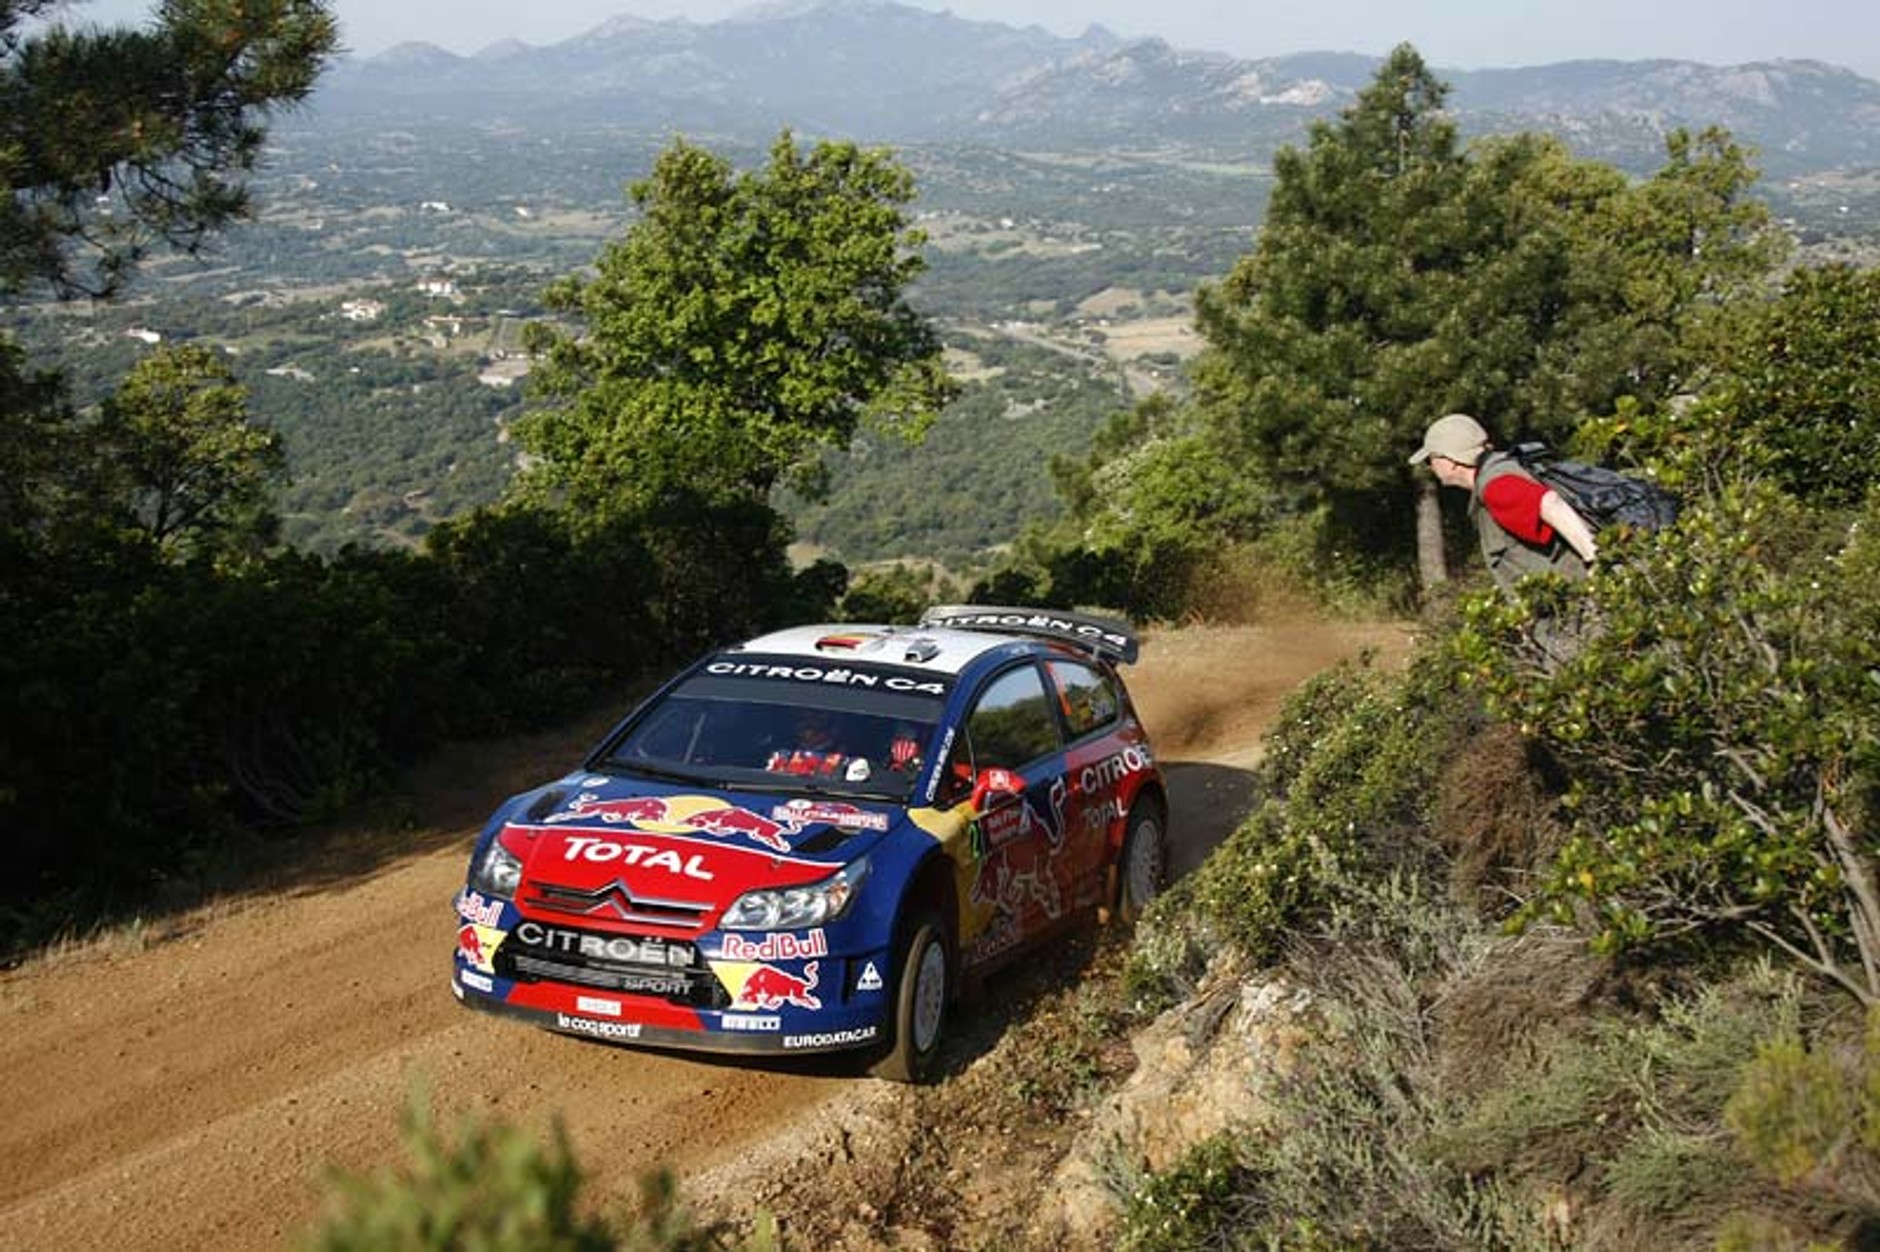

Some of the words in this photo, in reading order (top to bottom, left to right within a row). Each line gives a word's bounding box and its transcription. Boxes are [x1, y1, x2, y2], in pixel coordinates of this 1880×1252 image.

[706, 661, 879, 687] CITROËN
[884, 677, 945, 695] C4
[563, 836, 716, 881] TOTAL
[516, 922, 696, 966] CITROËN
[721, 933, 776, 962] Red
[777, 928, 828, 959] Bull
[783, 1026, 877, 1048] EURODATACAR
